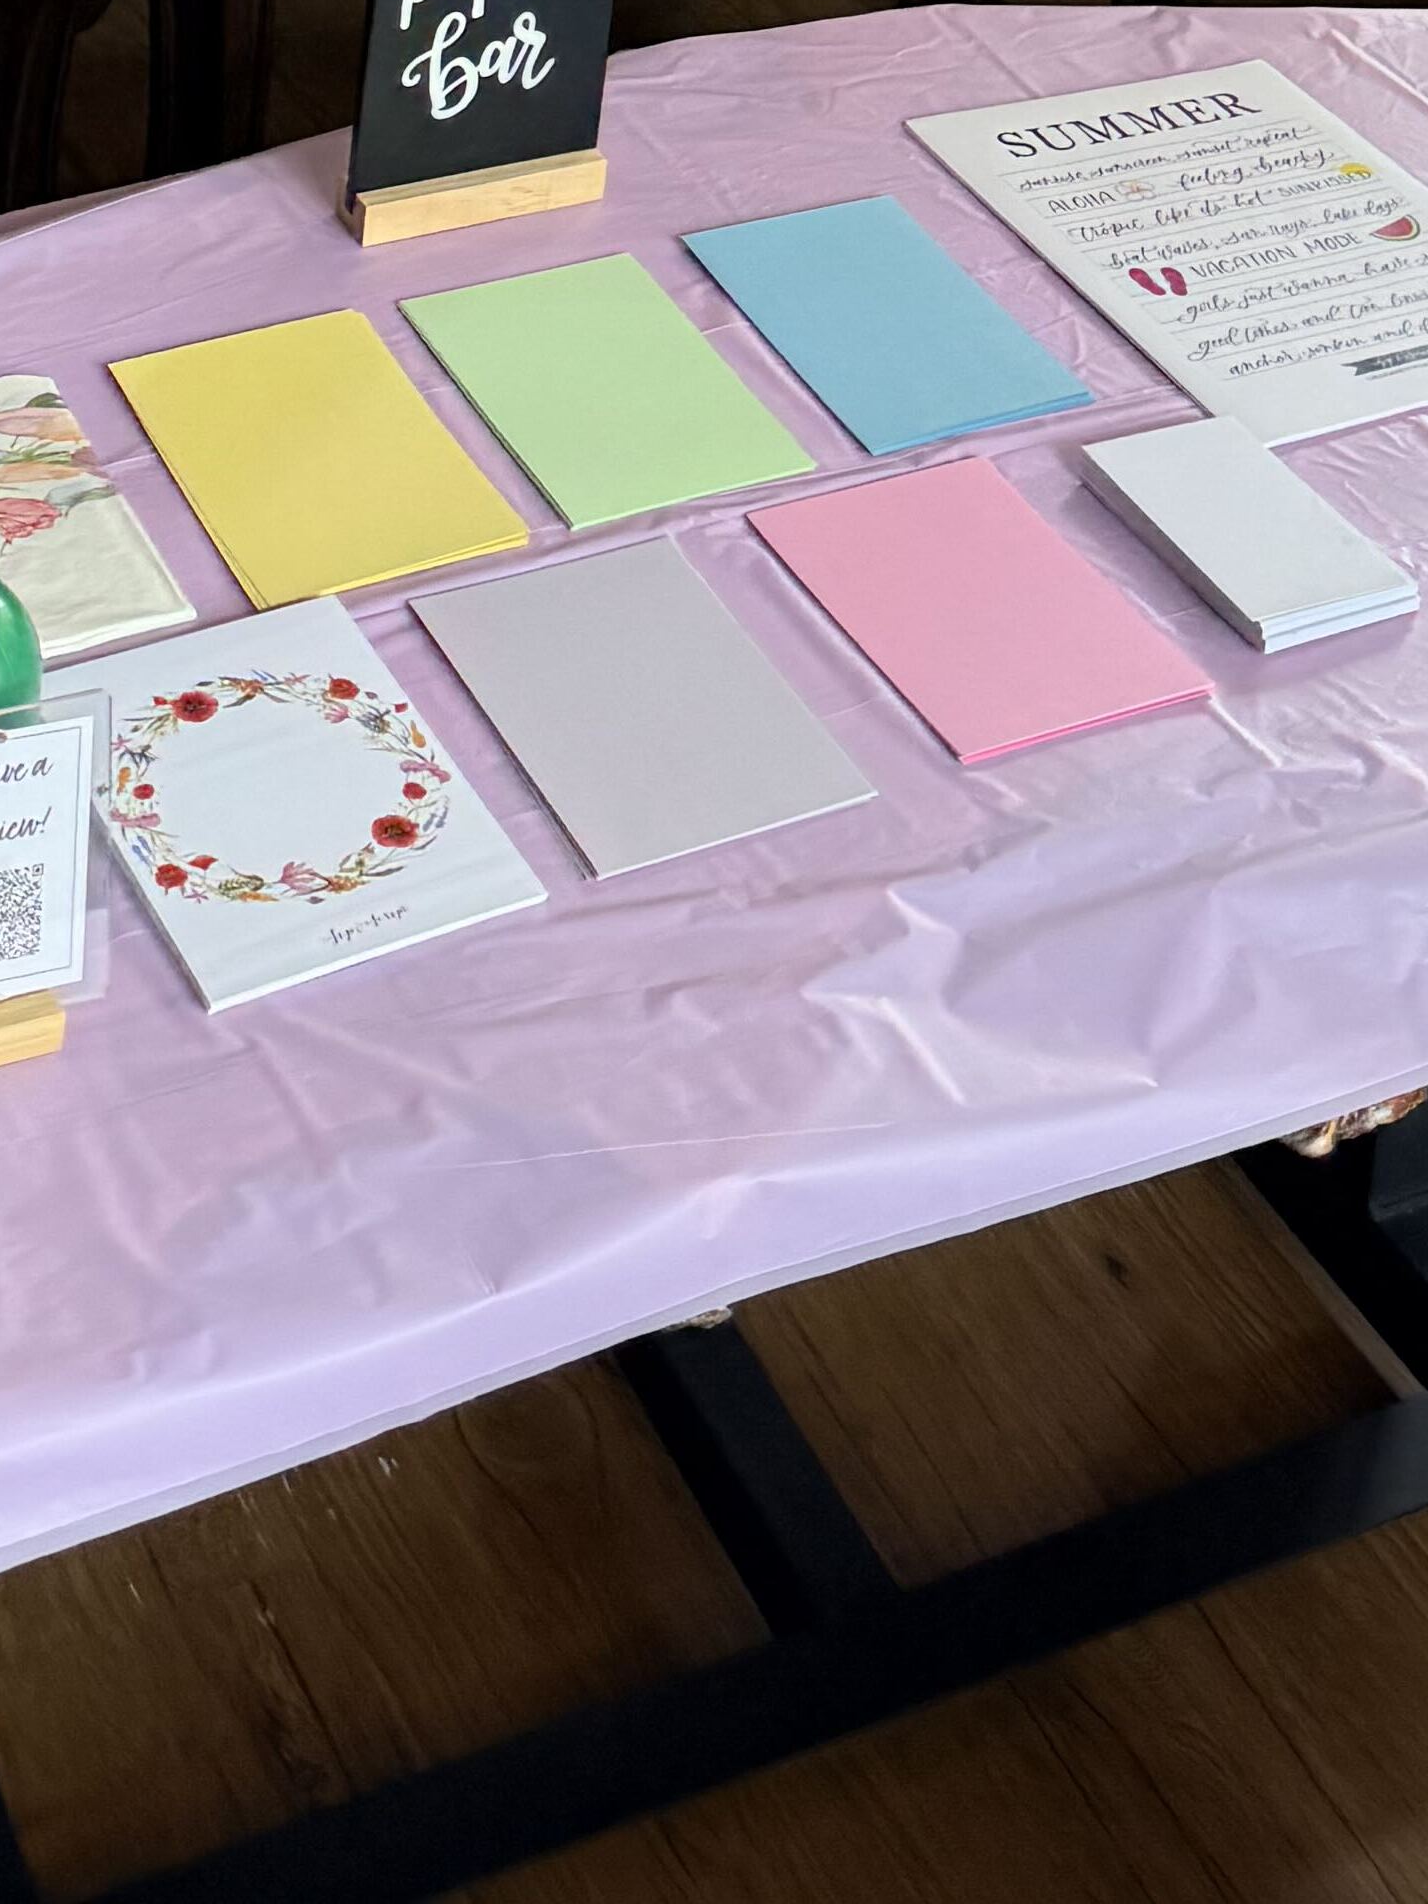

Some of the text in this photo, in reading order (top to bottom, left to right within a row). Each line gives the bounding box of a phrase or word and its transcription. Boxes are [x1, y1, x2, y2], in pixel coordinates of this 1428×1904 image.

[401, 10, 557, 121] bar
[996, 91, 1263, 159] SUMMER
[1048, 191, 1117, 214] ALOHA
[1189, 231, 1367, 278] VACATION MODE
[31, 756, 54, 777] a
